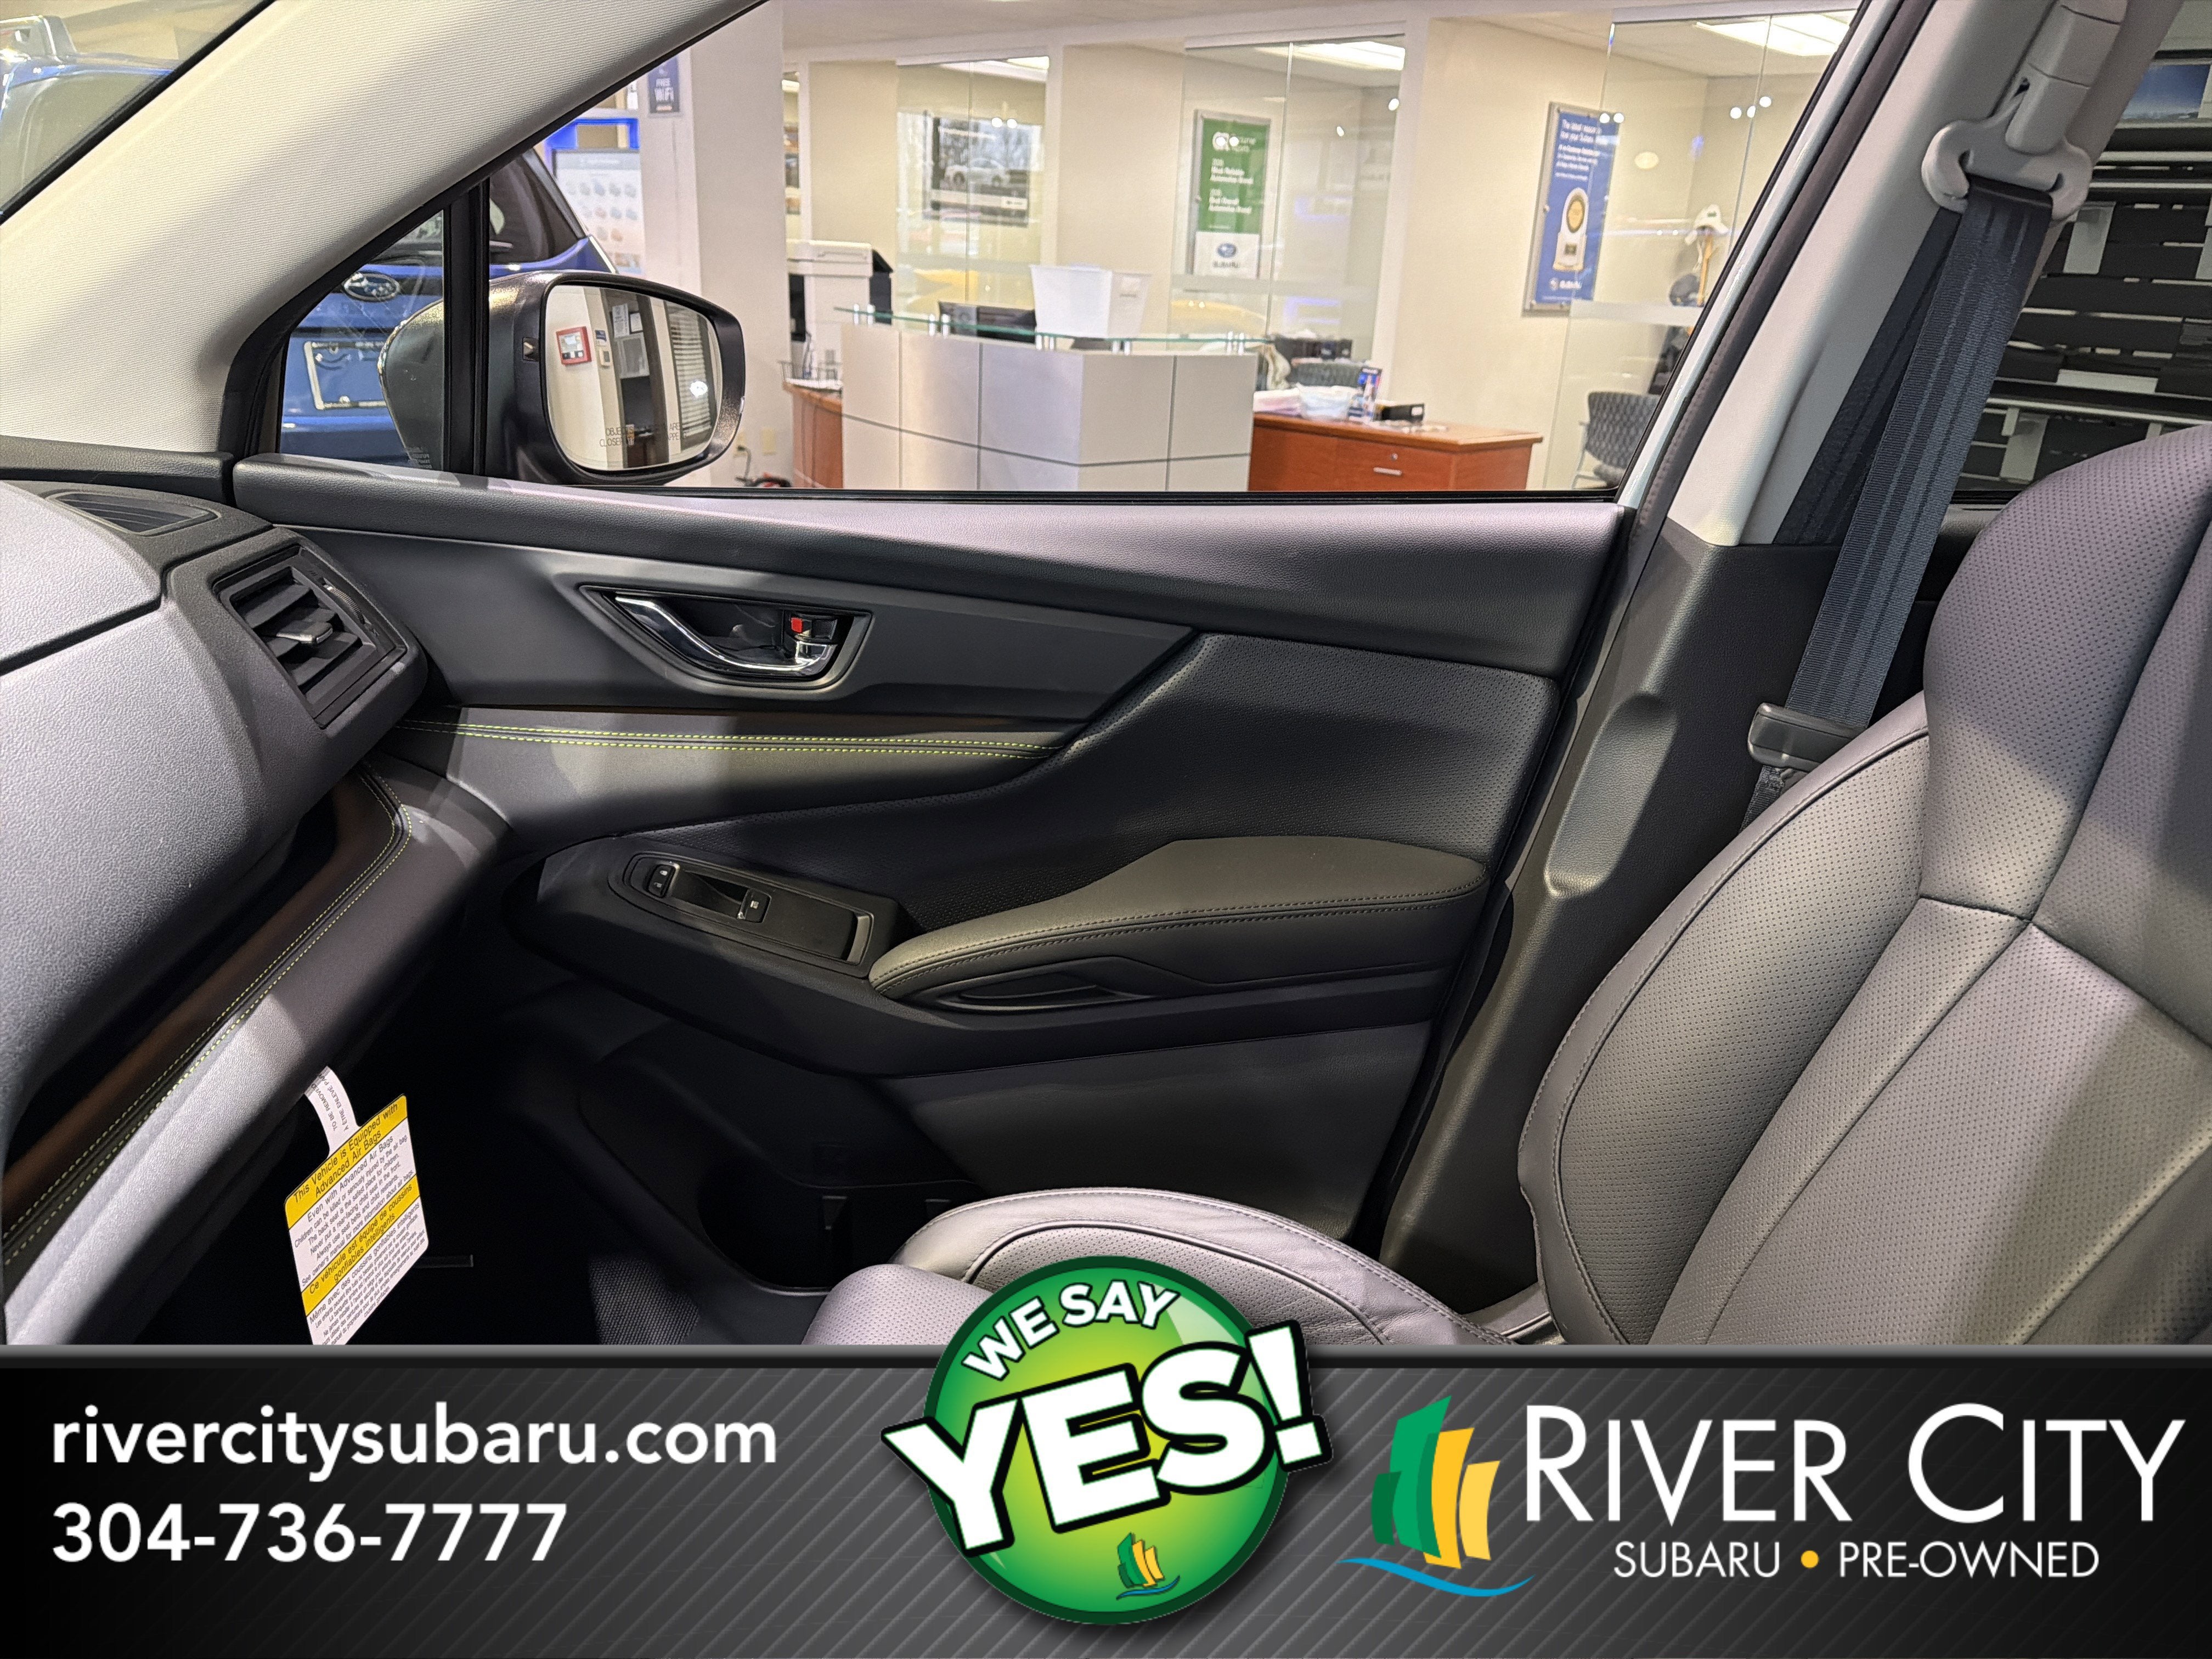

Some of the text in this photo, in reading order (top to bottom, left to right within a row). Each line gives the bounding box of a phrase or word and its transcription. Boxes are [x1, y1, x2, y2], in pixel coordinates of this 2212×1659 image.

[294, 1104, 398, 1203] This Vehicle is Equipped with
[328, 1111, 335, 1121] BE
[332, 1121, 337, 1131] TO
[295, 1227, 313, 1248] Children
[313, 1217, 323, 1229] can
[322, 1210, 329, 1220] be
[329, 1197, 341, 1213] killed
[341, 1192, 347, 1201] or
[347, 1175, 365, 1195] seriously
[365, 1160, 379, 1177] injured
[379, 1155, 385, 1164] by
[307, 1203, 324, 1223] Even
[325, 1189, 338, 1205] with
[340, 1158, 368, 1192] Advanced
[379, 1136, 393, 1153] Bags
[315, 1130, 381, 1198] Advanced Air Bags
[308, 1184, 412, 1294] Ce véhicule est équipé de coussins
[309, 1203, 420, 1324] Même avec des coussins gonflables intelligents
[334, 1213, 395, 1283] gonflables intelligents
